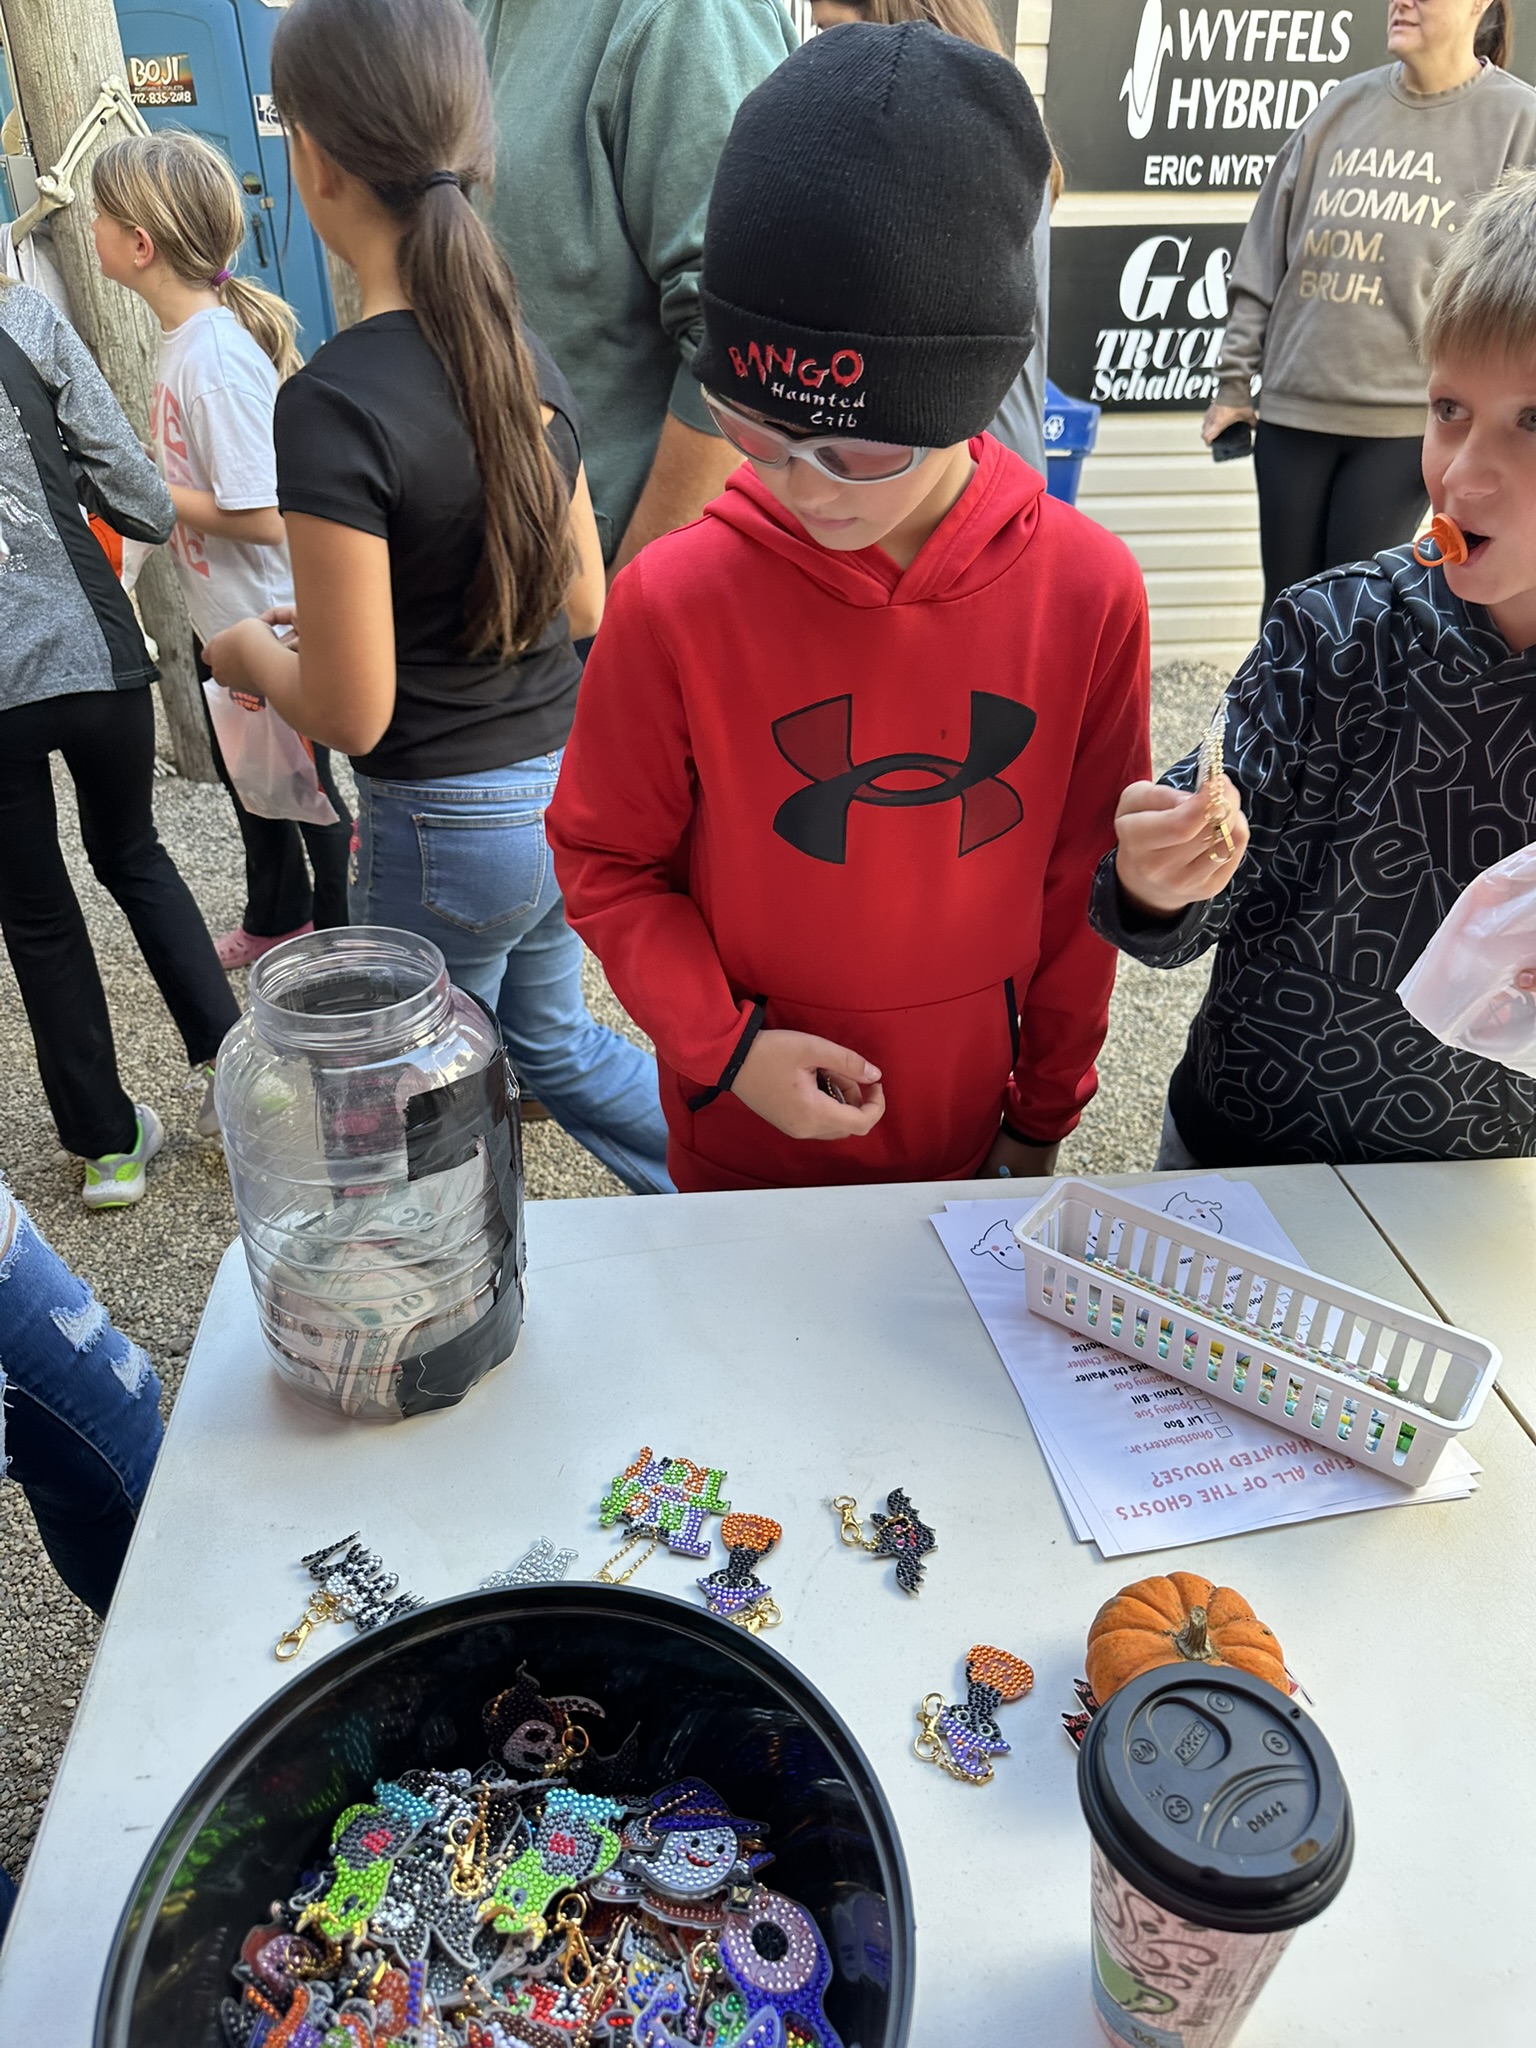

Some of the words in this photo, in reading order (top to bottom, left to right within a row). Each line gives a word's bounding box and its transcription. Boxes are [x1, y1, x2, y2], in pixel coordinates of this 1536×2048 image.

[1179, 8, 1353, 63] WYFFELS
[130, 56, 179, 87] BOJI
[1144, 154, 1204, 186] ERIC
[1328, 147, 1442, 185] MAMA.
[1313, 187, 1457, 233] MOMMY.
[1303, 228, 1385, 263] MOM.
[1299, 269, 1385, 306] BRUH.
[771, 381, 867, 408] Haunted
[810, 411, 858, 428] Crib
[391, 1293, 424, 1319] 10
[1066, 1357, 1102, 1369] Chiller
[1109, 1366, 1128, 1376] the
[1075, 1371, 1109, 1383] Wailer
[1130, 1386, 1184, 1406] Invisi-Bill
[1153, 1399, 1194, 1417] Spooky
[1134, 1405, 1153, 1419] Sue
[1164, 1418, 1185, 1430] Boo
[1141, 1429, 1215, 1453] Ghostbusters
[1230, 1438, 1314, 1467] HAUNTED
[1151, 1457, 1224, 1488] HOUSE?
[1273, 1465, 1306, 1484] ALL
[1313, 1455, 1356, 1477] FIND
[1196, 1483, 1237, 1504] THE
[1242, 1477, 1267, 1492] OF
[1115, 1494, 1193, 1521] GHOSTS
[1167, 1799, 1189, 1819] CS
[1246, 1801, 1289, 1834] D9542
